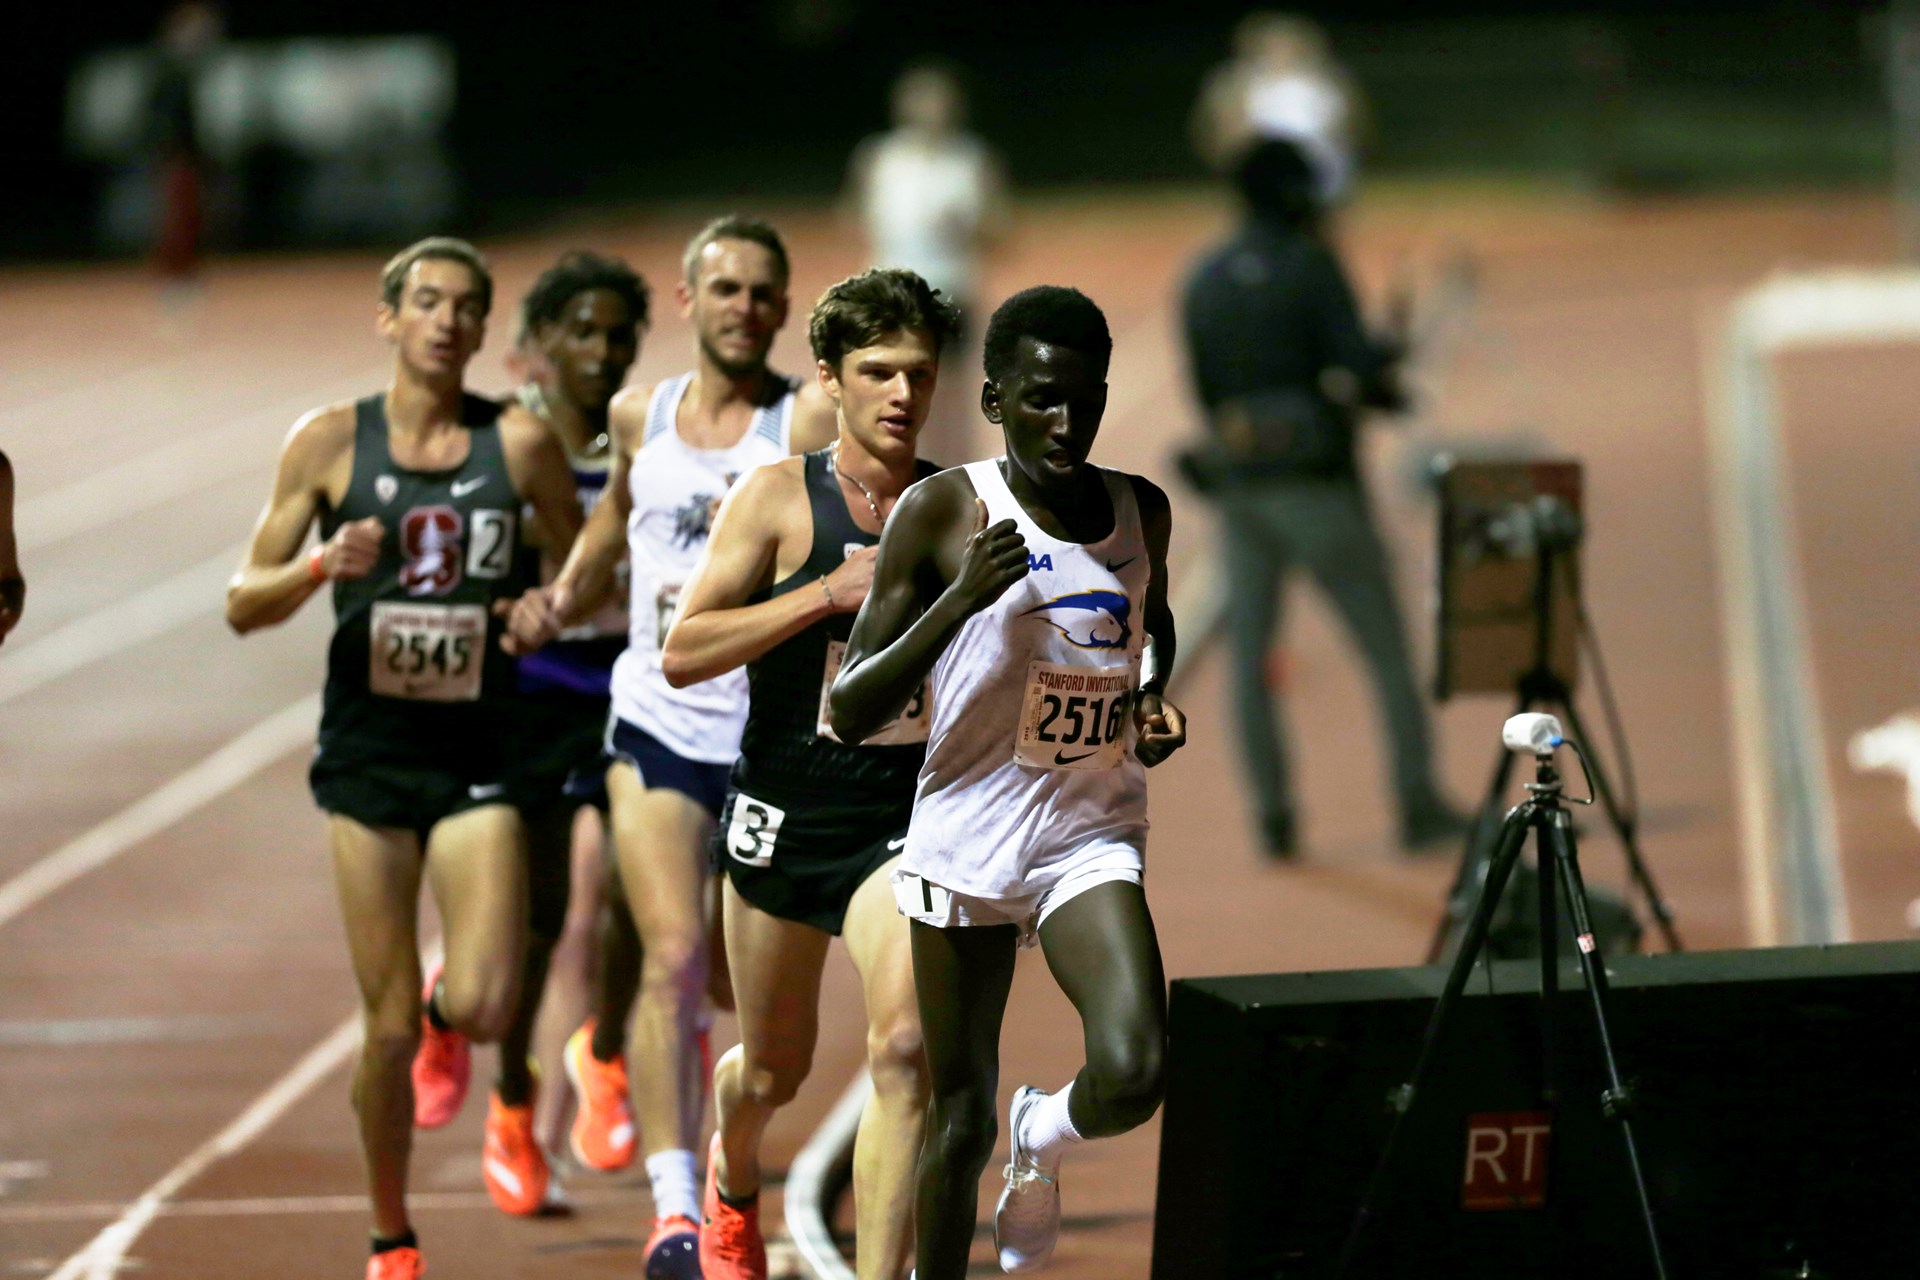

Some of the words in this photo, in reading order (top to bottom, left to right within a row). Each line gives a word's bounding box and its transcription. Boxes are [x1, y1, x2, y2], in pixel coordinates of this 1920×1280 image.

[480, 518, 504, 569] 2
[1025, 554, 1053, 571] AA
[388, 633, 470, 676] 2545
[1037, 671, 1084, 691] STANFORD
[1086, 674, 1129, 692] INVITATIONAL
[1038, 694, 1122, 746] 2516
[735, 803, 769, 859] 3
[1464, 1125, 1550, 1185] RT
